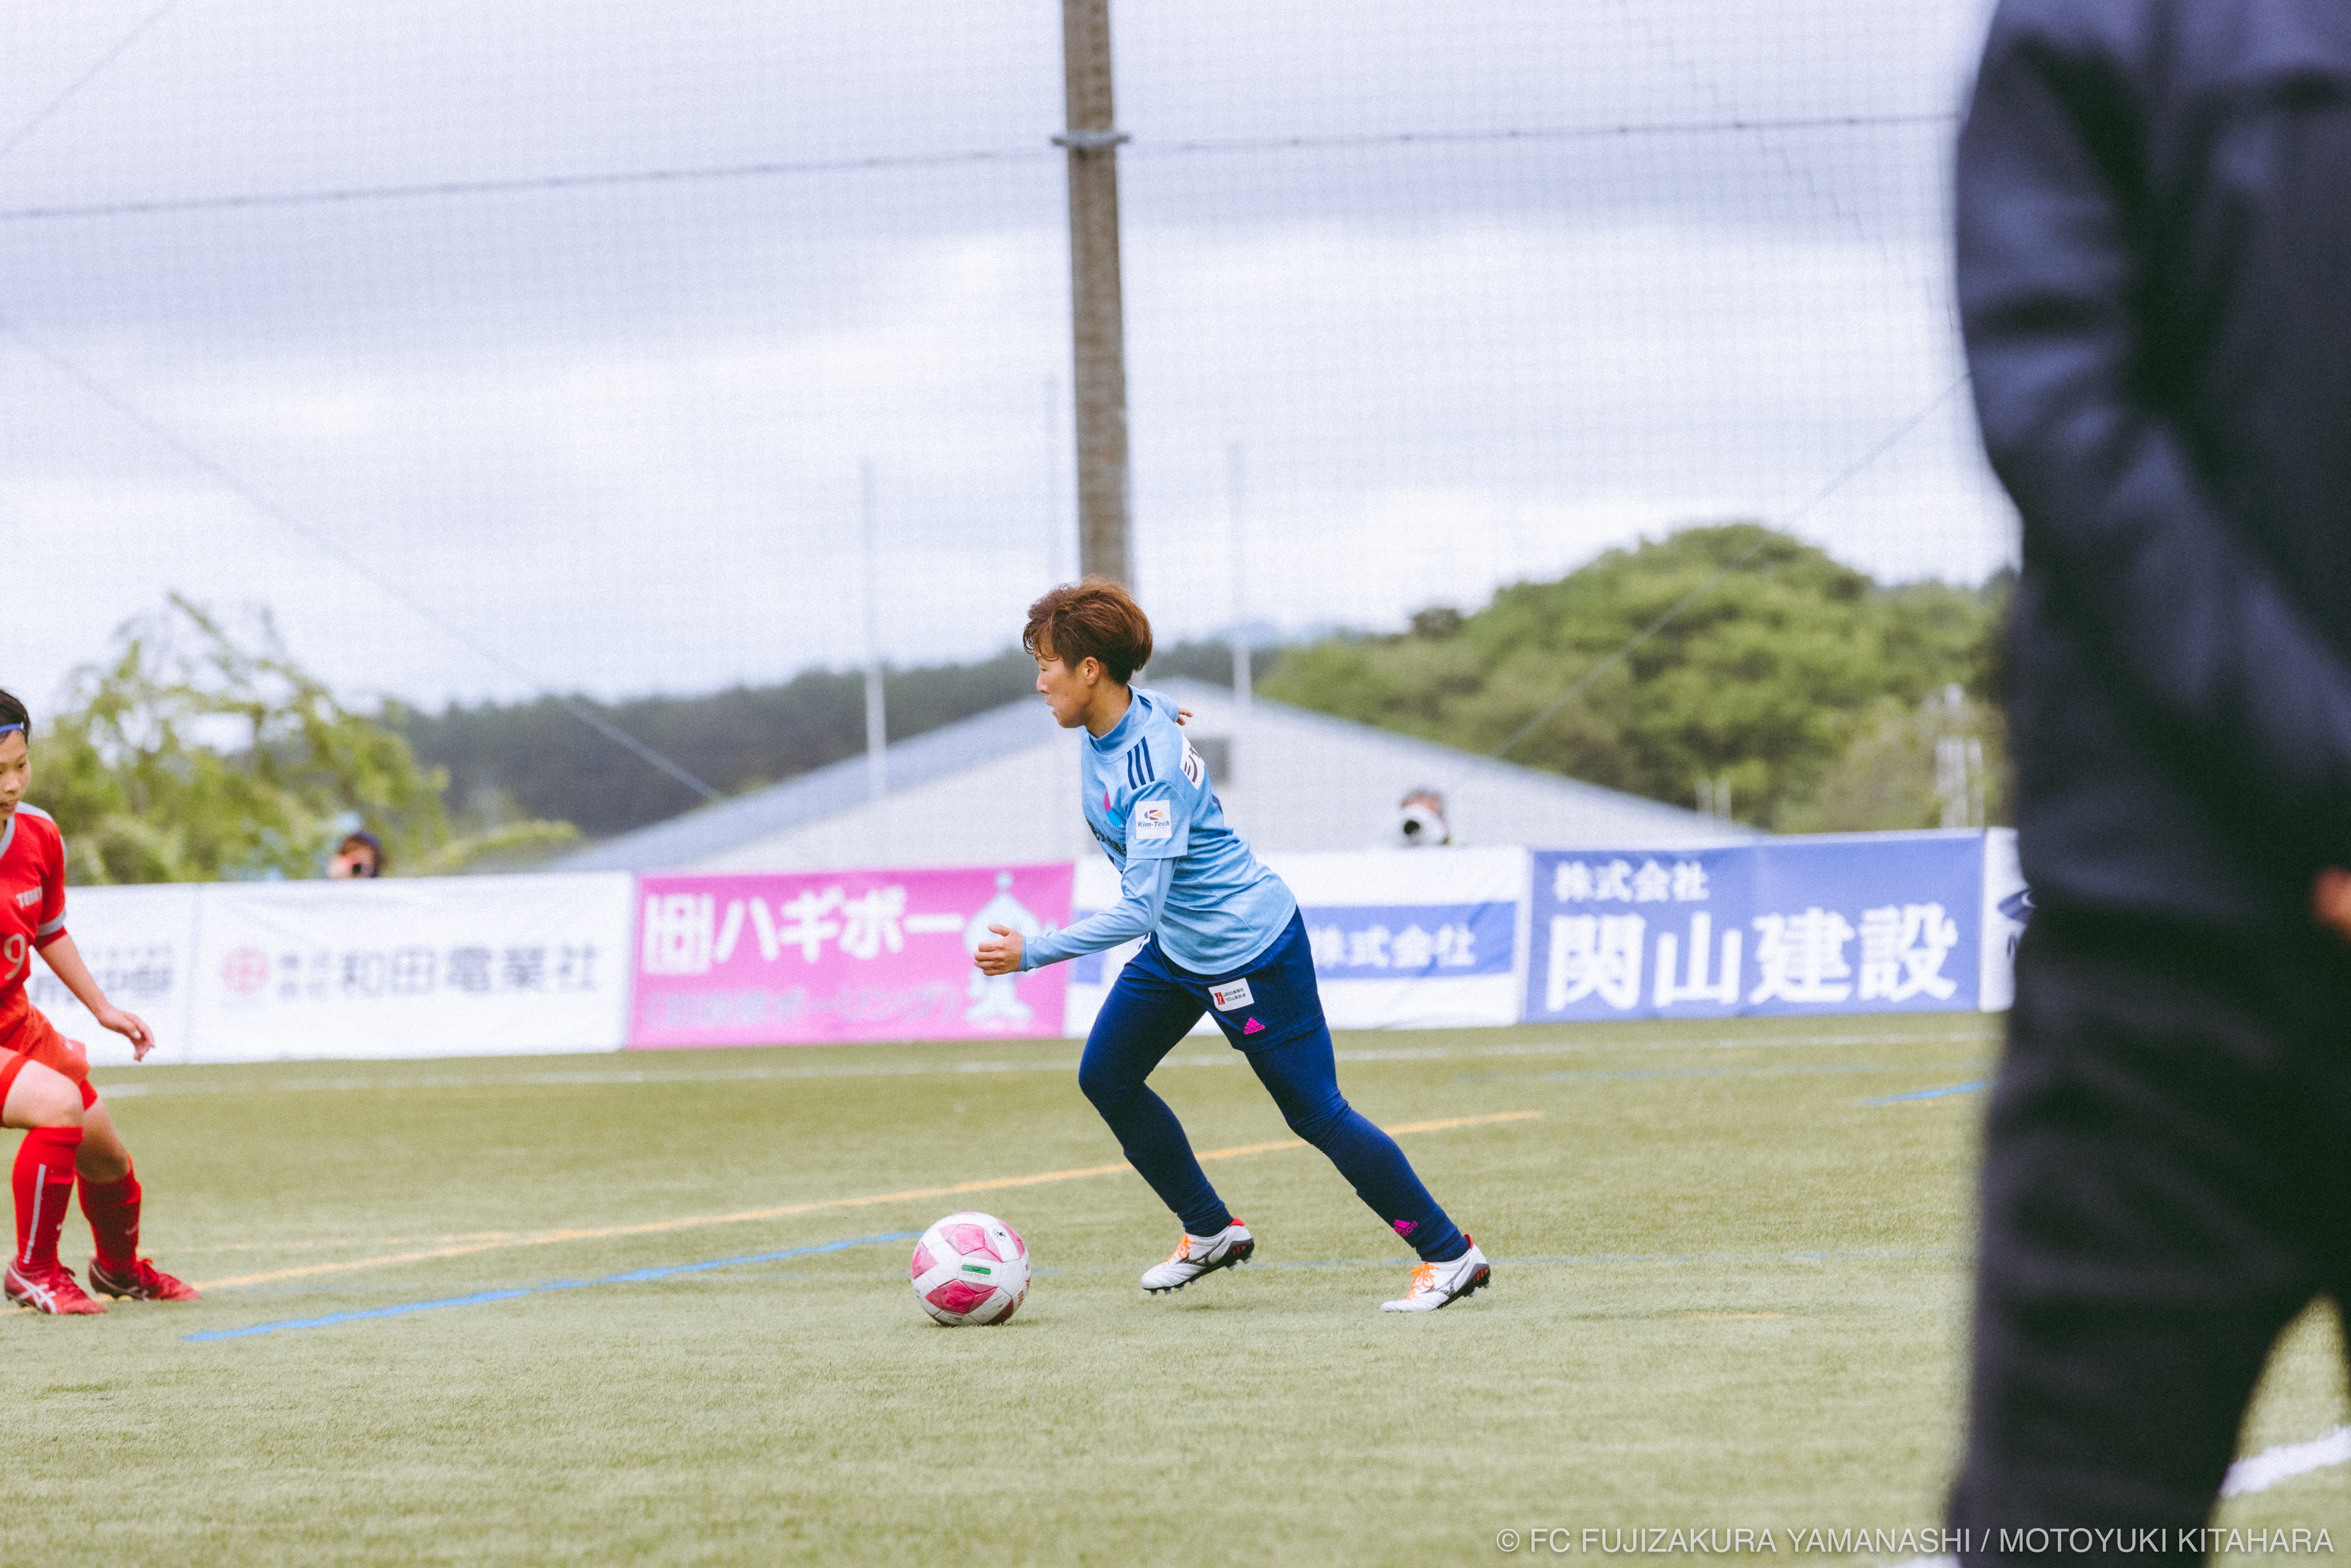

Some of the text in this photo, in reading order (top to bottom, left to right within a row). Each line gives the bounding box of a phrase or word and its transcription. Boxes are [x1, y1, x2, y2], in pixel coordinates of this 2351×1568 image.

[1552, 860, 1710, 903] 株式会社
[1545, 903, 1958, 1011] 関山建設
[1244, 1025, 1265, 1035] adidas
